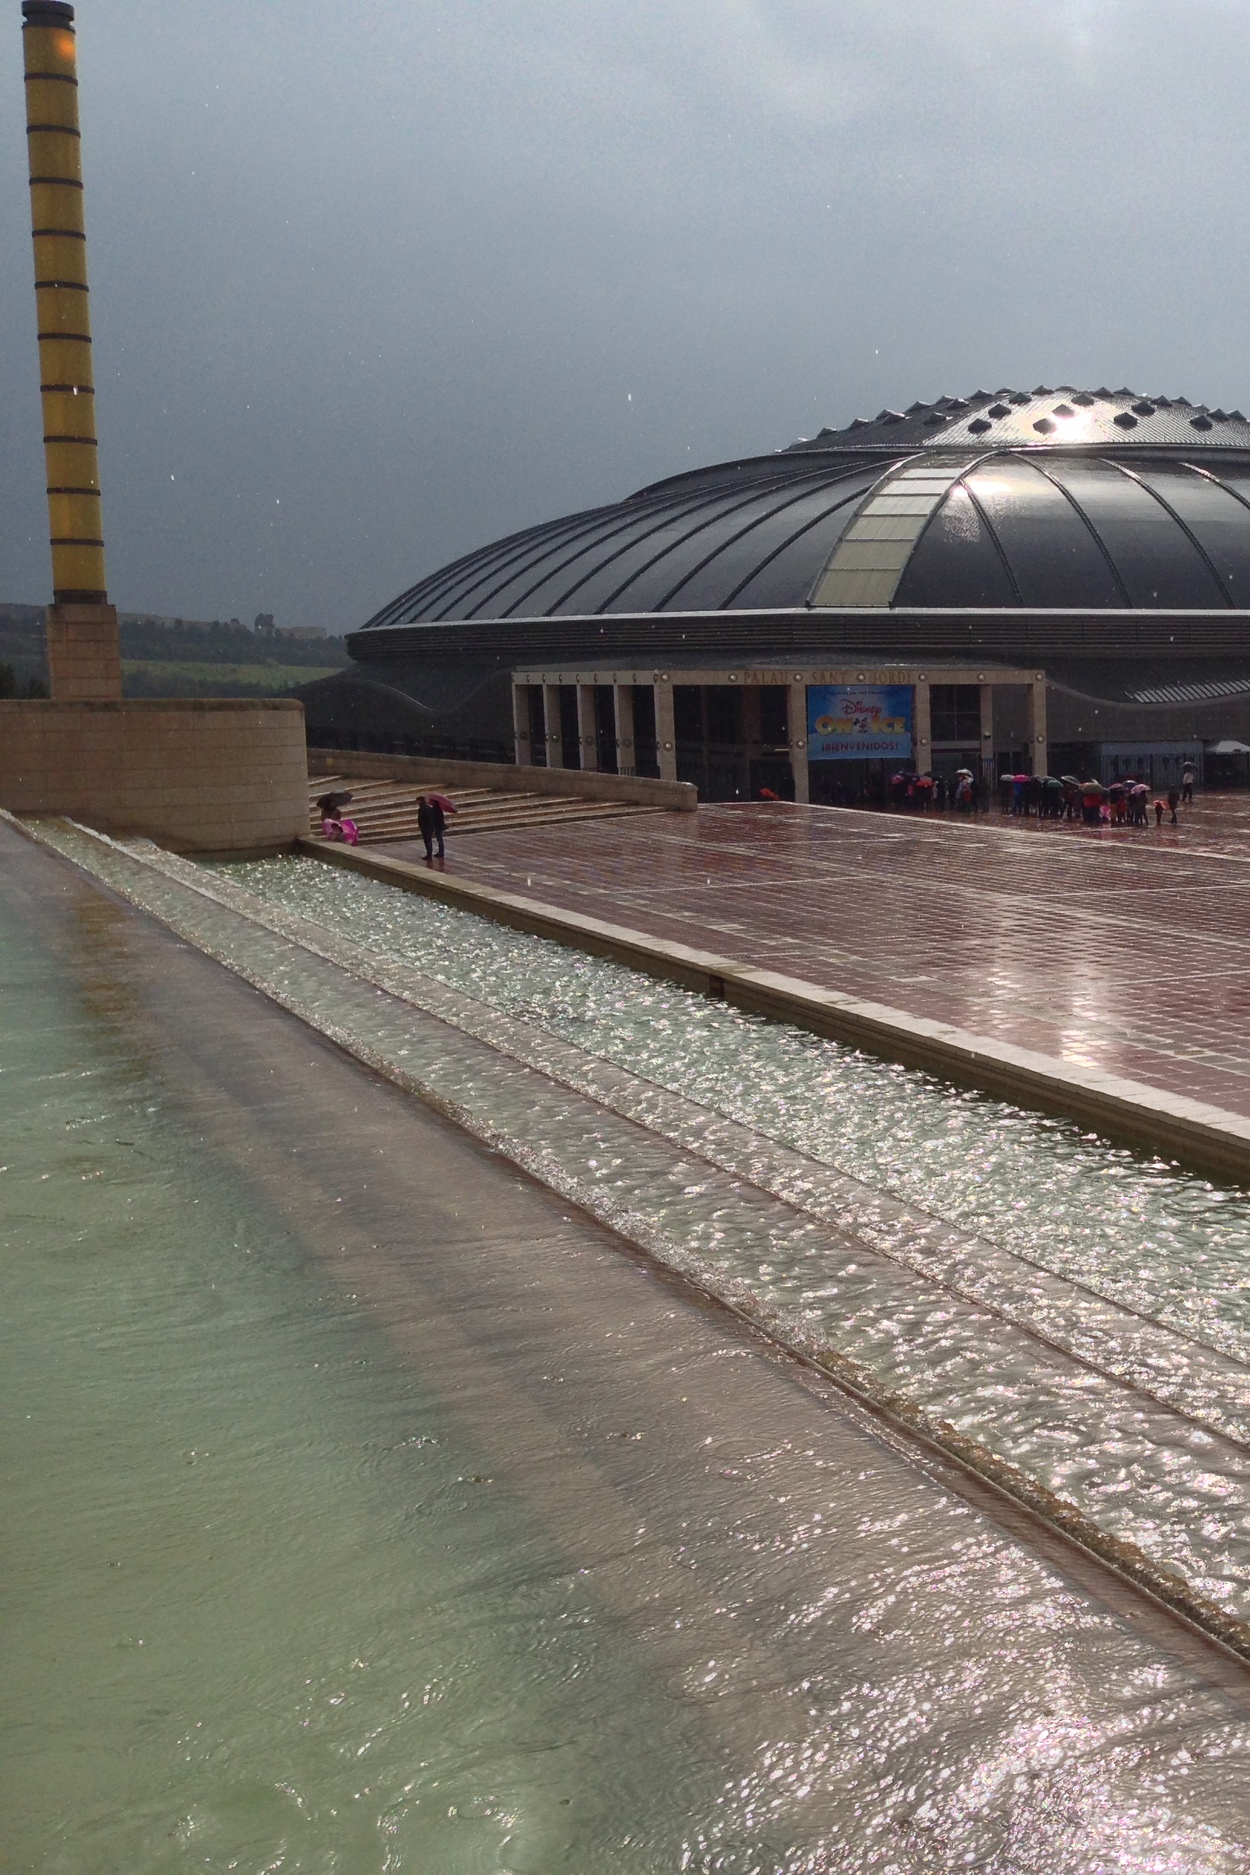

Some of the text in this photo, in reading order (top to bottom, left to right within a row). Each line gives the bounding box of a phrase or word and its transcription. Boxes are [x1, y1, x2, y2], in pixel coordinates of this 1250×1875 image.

[744, 672, 912, 684] PALAU SANT JORDI
[841, 699, 882, 715] Disney
[822, 742, 898, 752] ¡BIENVENIDOS!
